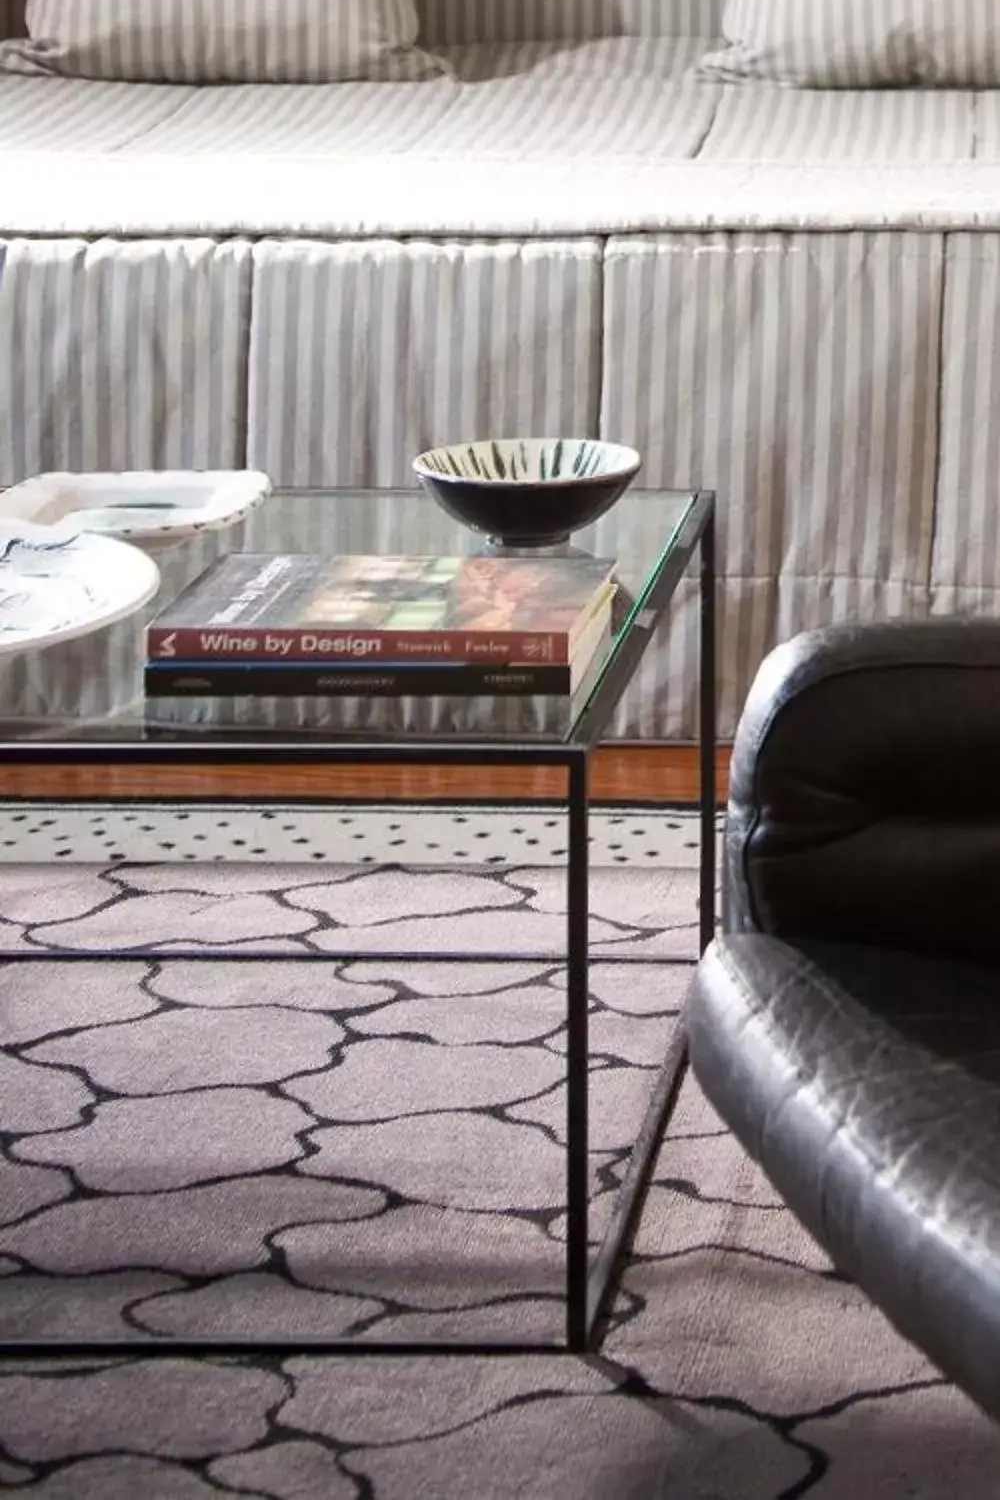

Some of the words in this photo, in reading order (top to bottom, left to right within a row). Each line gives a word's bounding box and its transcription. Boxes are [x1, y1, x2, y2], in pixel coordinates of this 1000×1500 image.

[200, 634, 258, 651] Wine
[265, 634, 294, 655] by
[301, 635, 381, 655] Design
